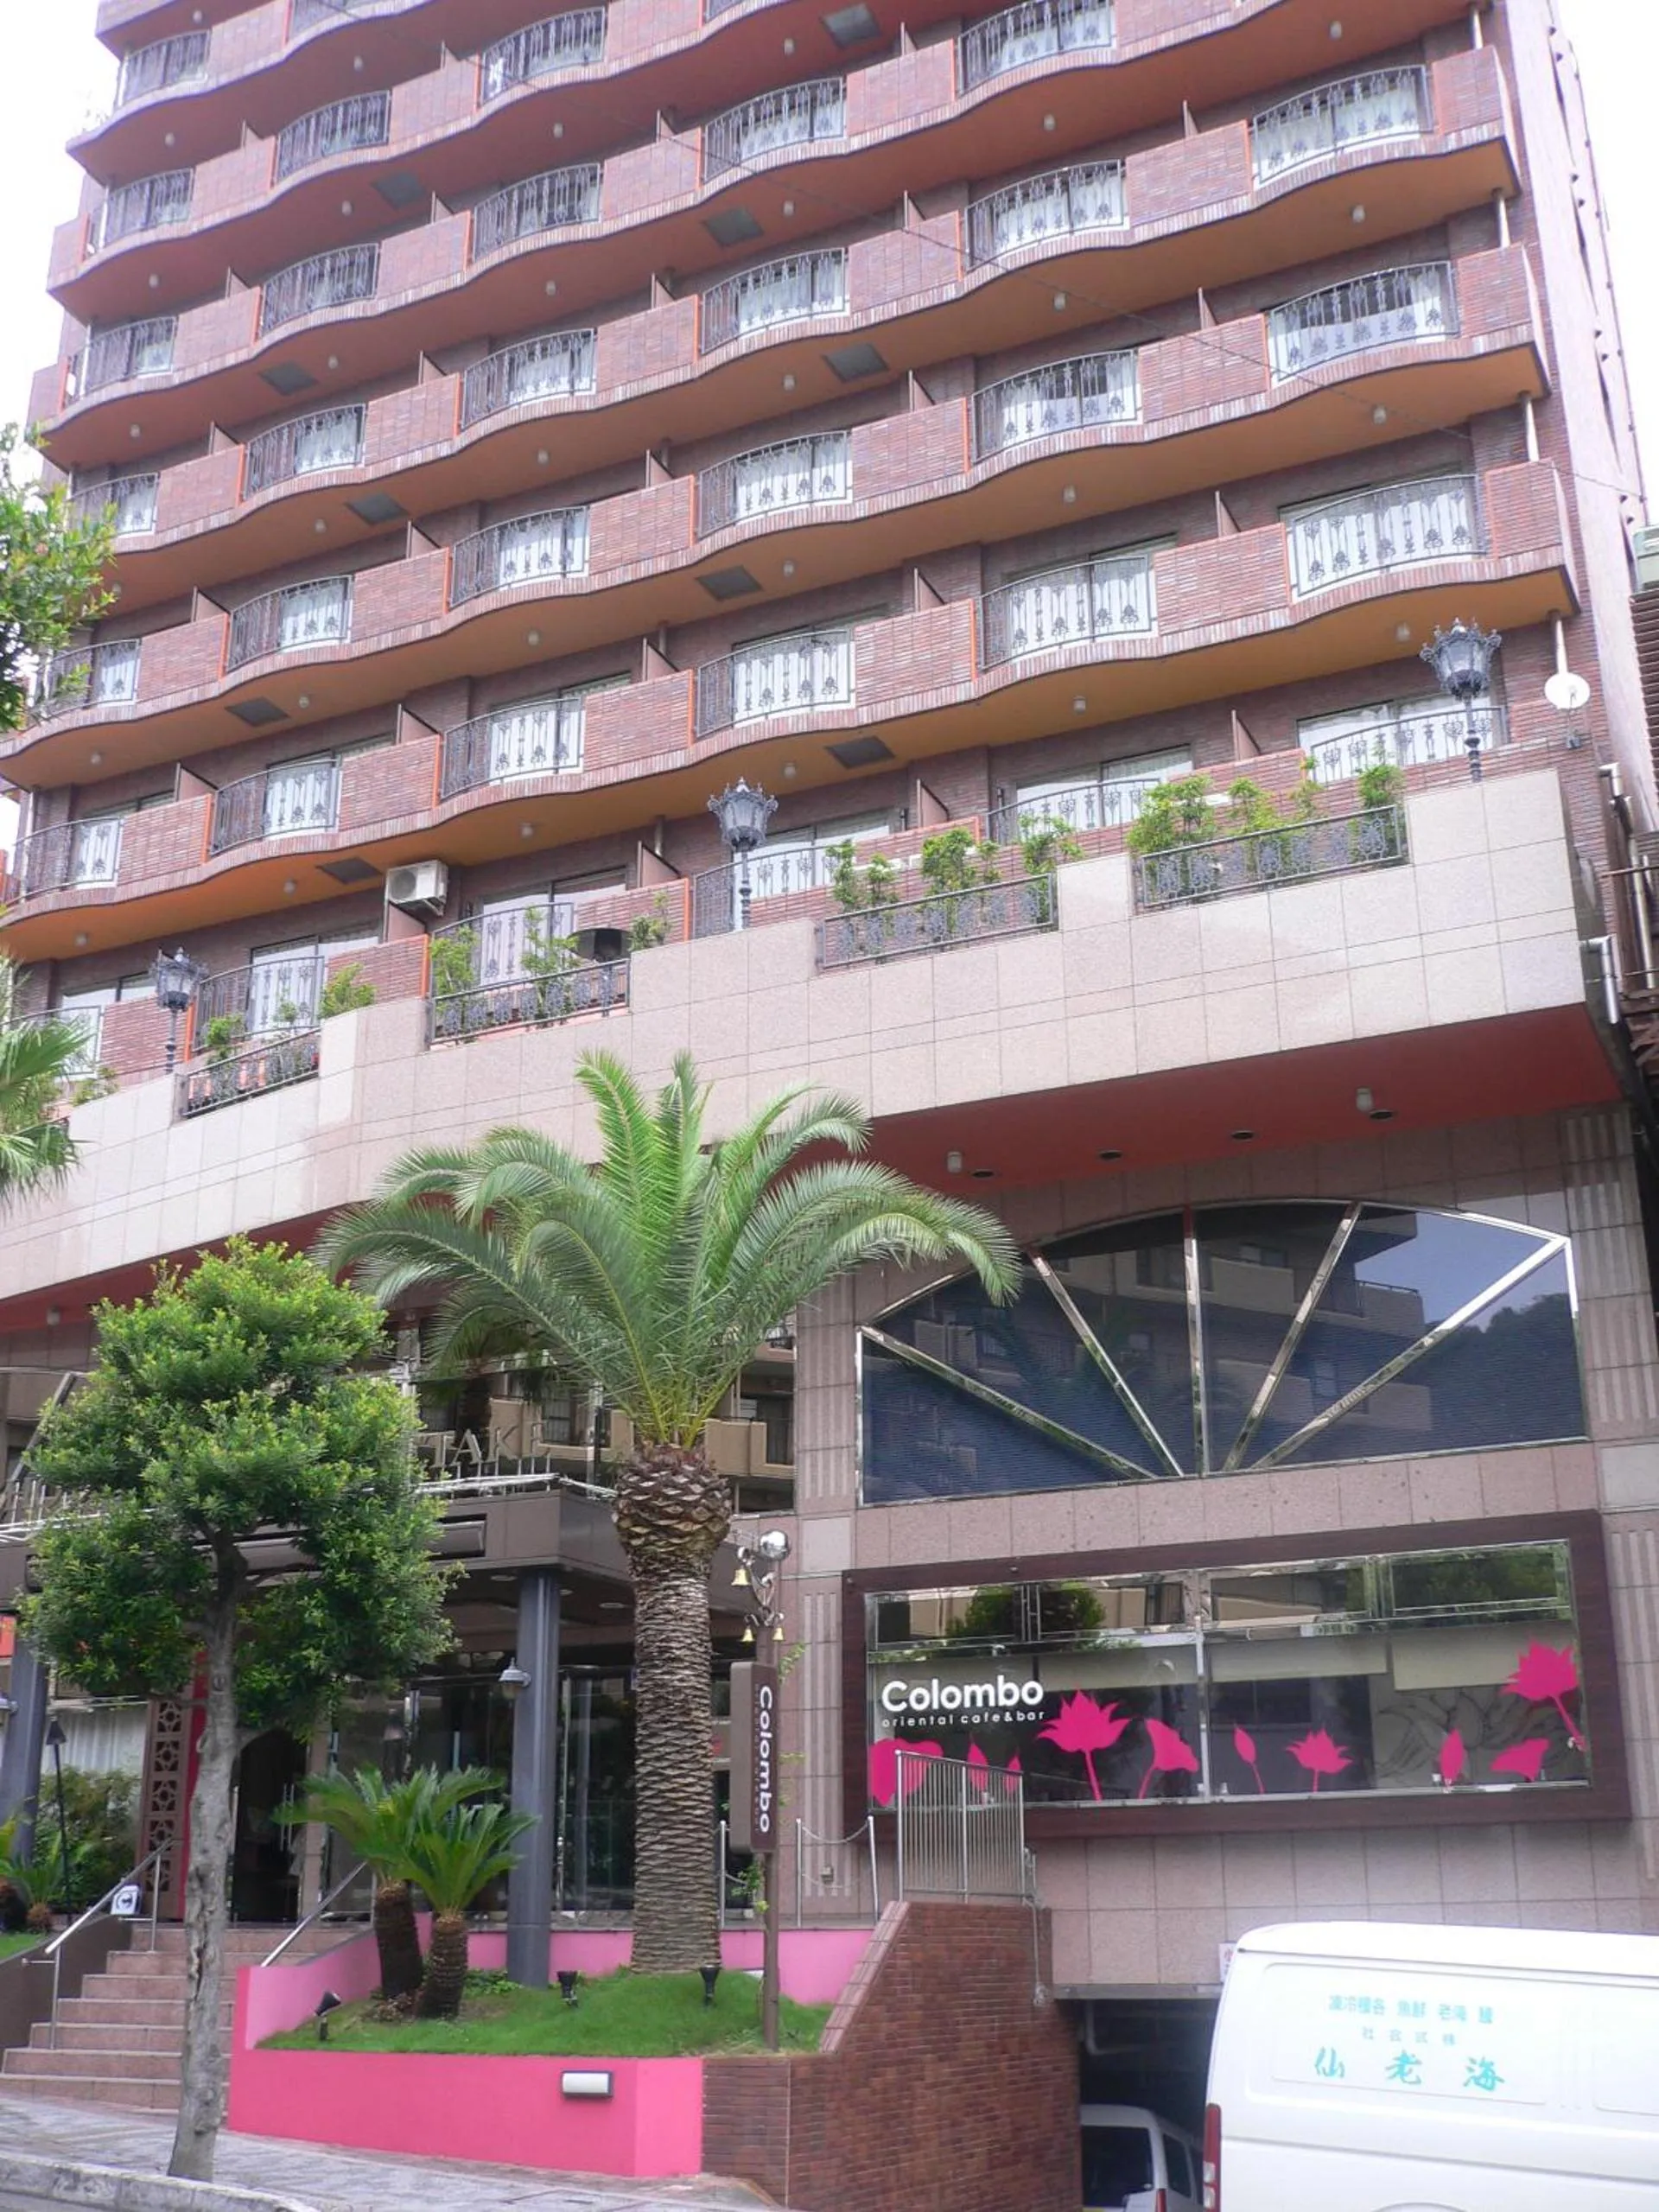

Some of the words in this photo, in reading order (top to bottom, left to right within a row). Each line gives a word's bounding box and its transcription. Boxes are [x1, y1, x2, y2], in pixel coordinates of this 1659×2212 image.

[881, 1675, 1044, 1713] Colombo
[881, 1714, 954, 1728] oriental
[760, 1686, 772, 1833] Colombo
